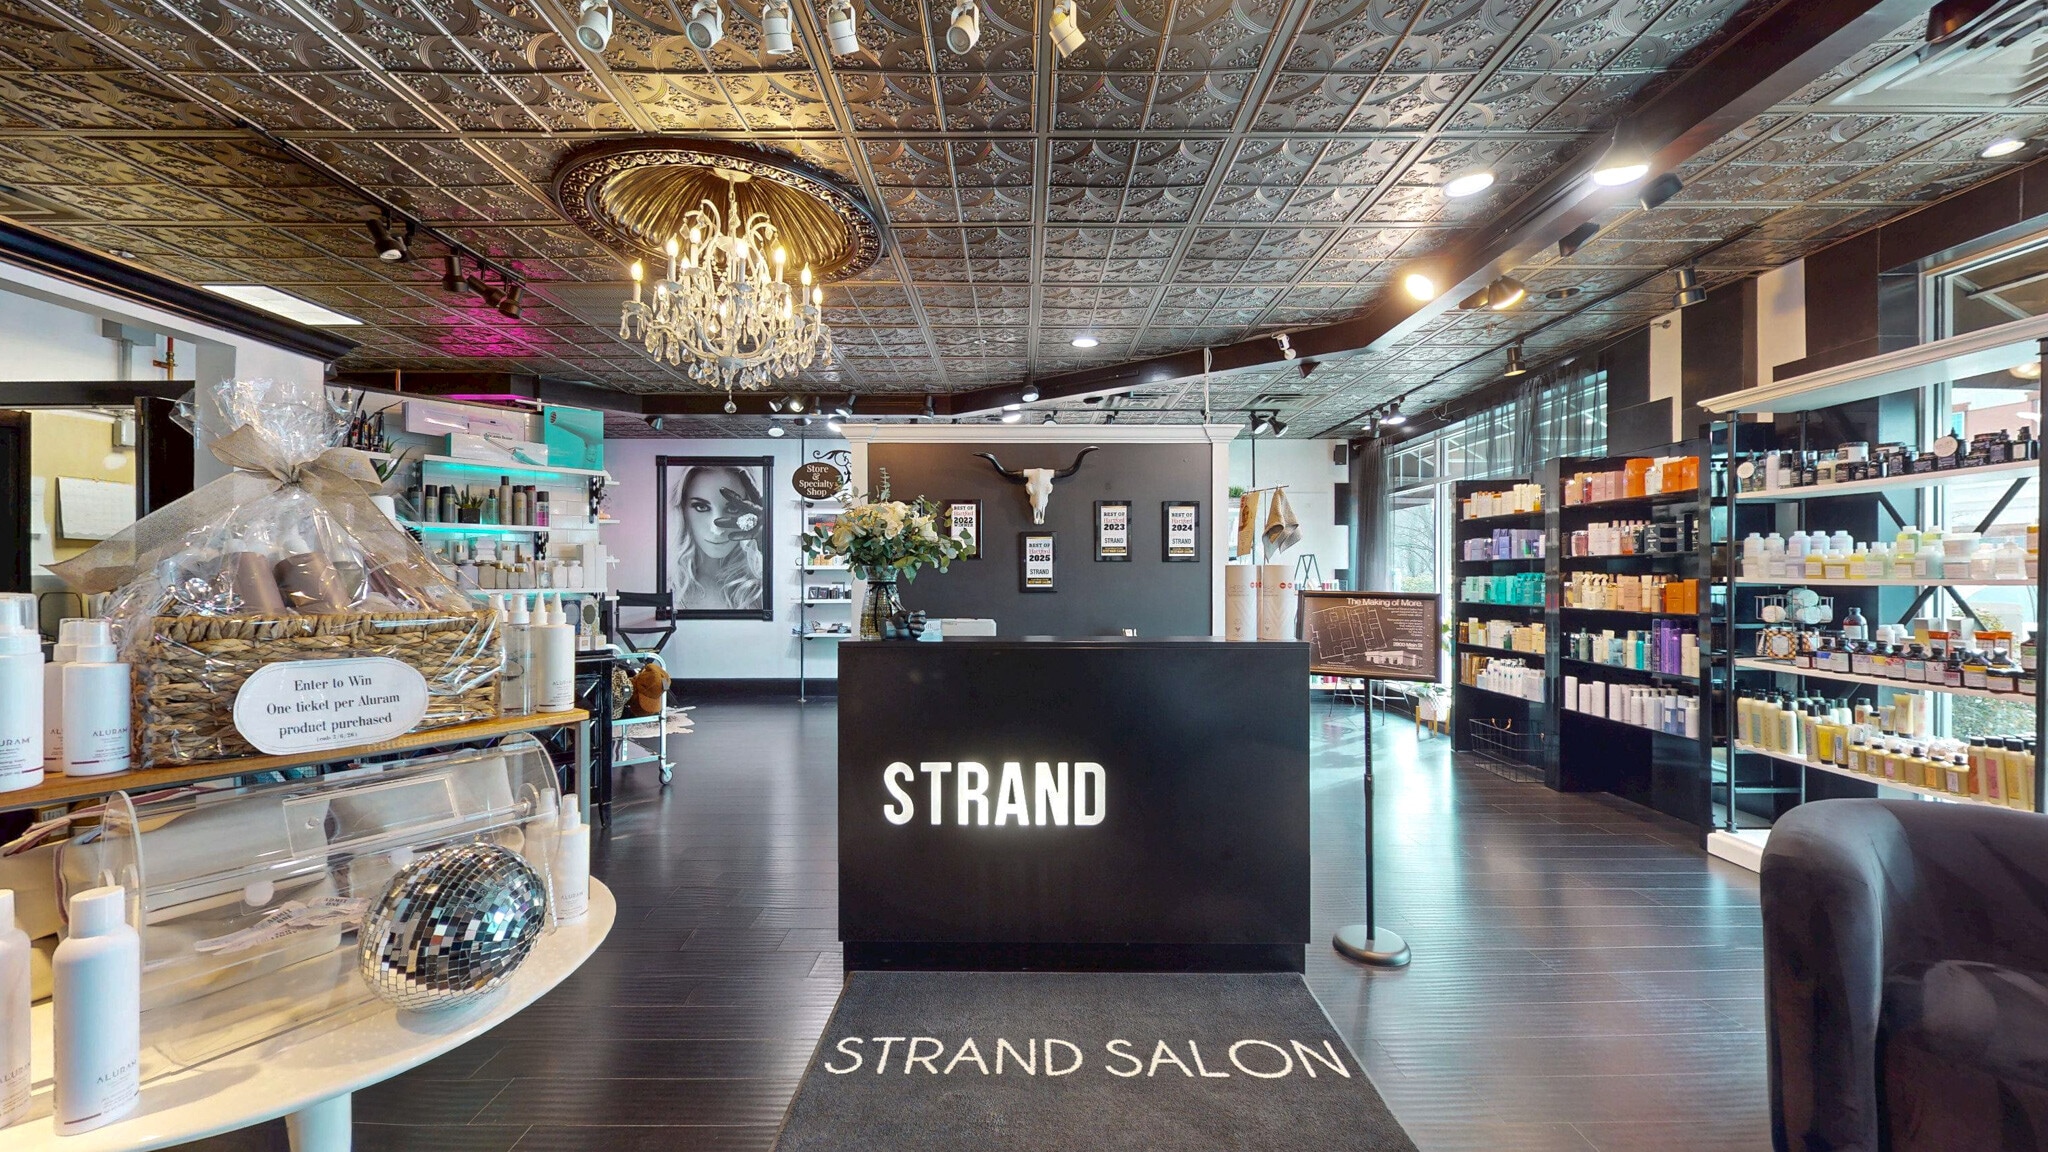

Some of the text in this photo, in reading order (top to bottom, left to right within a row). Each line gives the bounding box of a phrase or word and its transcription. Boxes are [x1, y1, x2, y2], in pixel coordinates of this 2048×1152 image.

[806, 464, 829, 473] Store
[798, 480, 834, 489] Specialty
[806, 488, 827, 496] Shop
[1363, 599, 1390, 607] Making
[1401, 599, 1423, 607] More.
[294, 675, 372, 692] Enter to Win
[266, 693, 401, 715] One ticket per Aluram
[92, 728, 128, 737] ALURAM
[279, 712, 392, 739] product purchased
[884, 761, 1106, 826] STRAND
[267, 908, 292, 924] ADMIT
[824, 1037, 1351, 1079] STRAND SALON
